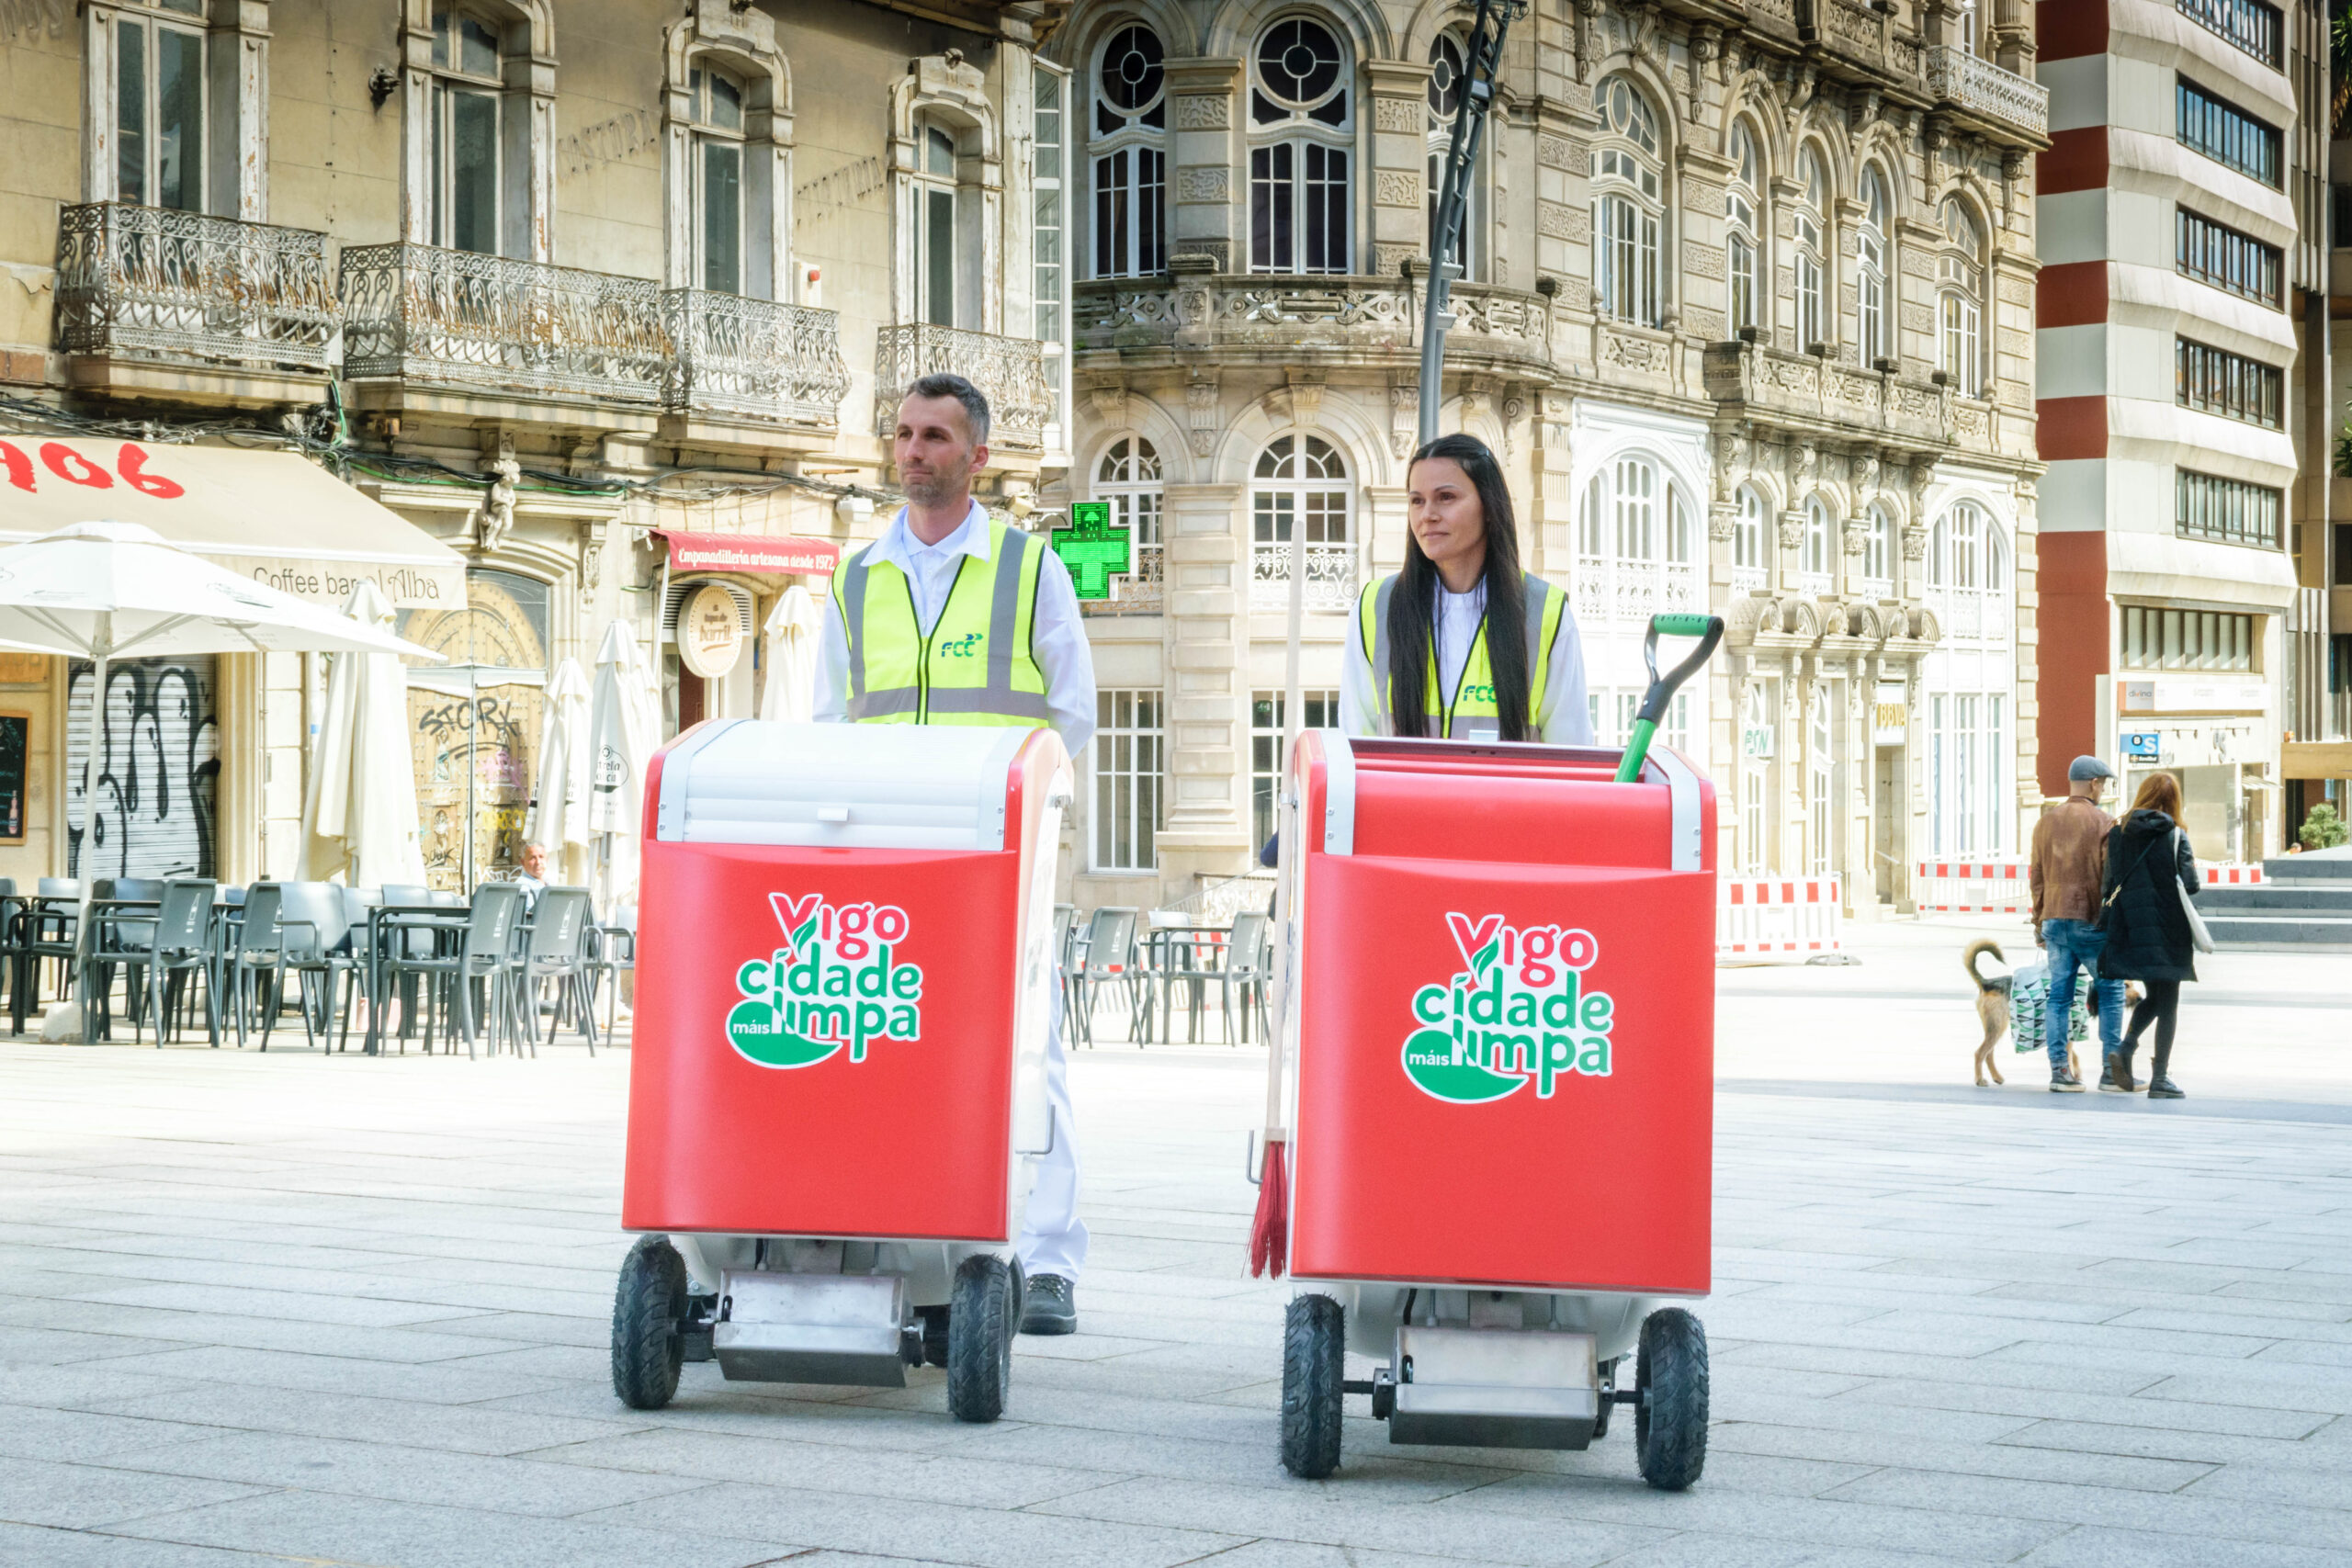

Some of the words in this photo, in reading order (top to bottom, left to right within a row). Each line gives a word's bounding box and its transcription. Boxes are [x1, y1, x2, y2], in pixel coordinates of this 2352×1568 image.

[254, 567, 319, 593] Coffee
[325, 570, 356, 595] bar
[388, 569, 440, 603] Alba
[678, 547, 750, 567] Empanadillería
[751, 551, 789, 567] artesana
[790, 554, 814, 569] desde
[941, 641, 976, 657] FCC
[1746, 729, 1769, 754] PSN
[1880, 704, 1905, 726] BBVA
[771, 895, 907, 960] Vigo
[1449, 916, 1595, 987] Vigo
[739, 942, 920, 999] cidade
[732, 1020, 770, 1034] máis
[771, 990, 917, 1059] limpa
[1415, 967, 1611, 1032] cidade
[1408, 1050, 1450, 1066] máis
[1451, 1018, 1609, 1095] limpa
